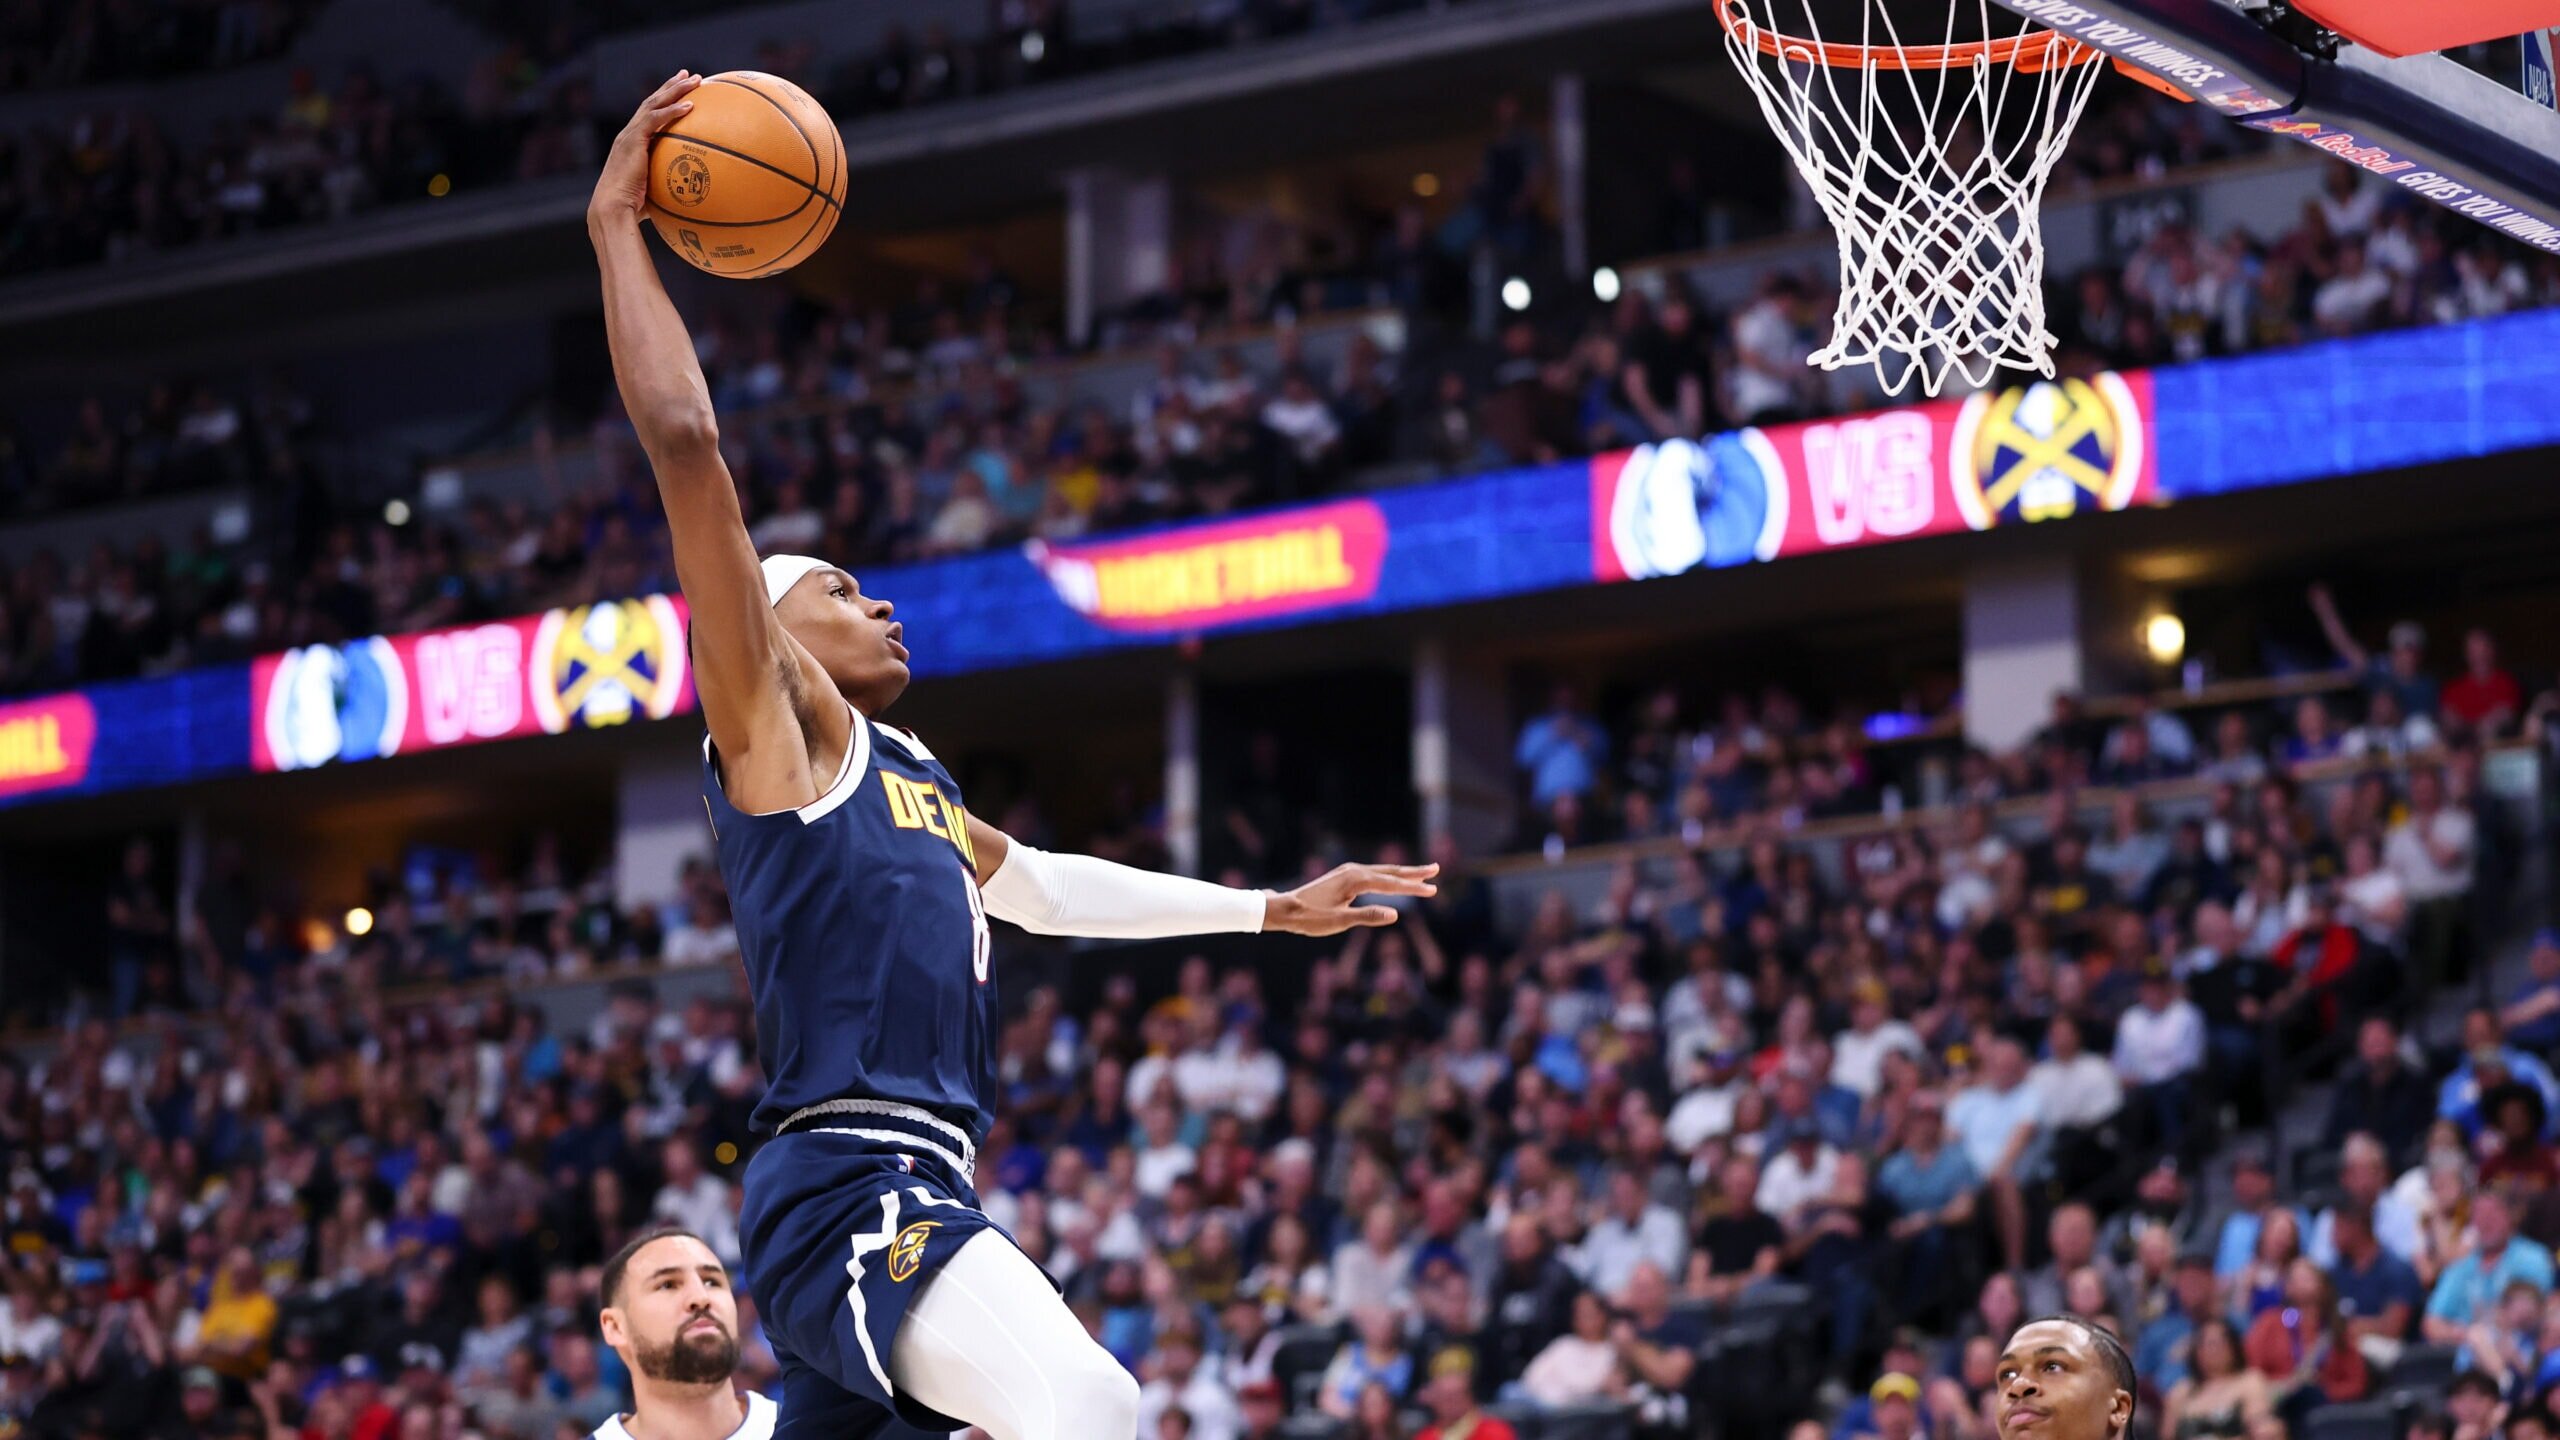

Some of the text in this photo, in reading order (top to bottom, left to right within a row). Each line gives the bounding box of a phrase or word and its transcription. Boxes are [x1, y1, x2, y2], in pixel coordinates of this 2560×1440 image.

[2075, 20, 2147, 46] YOU
[2528, 63, 2549, 105] NBA
[2396, 172, 2473, 200] GIVES
[2449, 194, 2514, 218] YOU
[1802, 411, 1934, 545] VS
[414, 623, 523, 745] VS
[879, 769, 977, 874] DEN
[961, 866, 991, 985] 8
